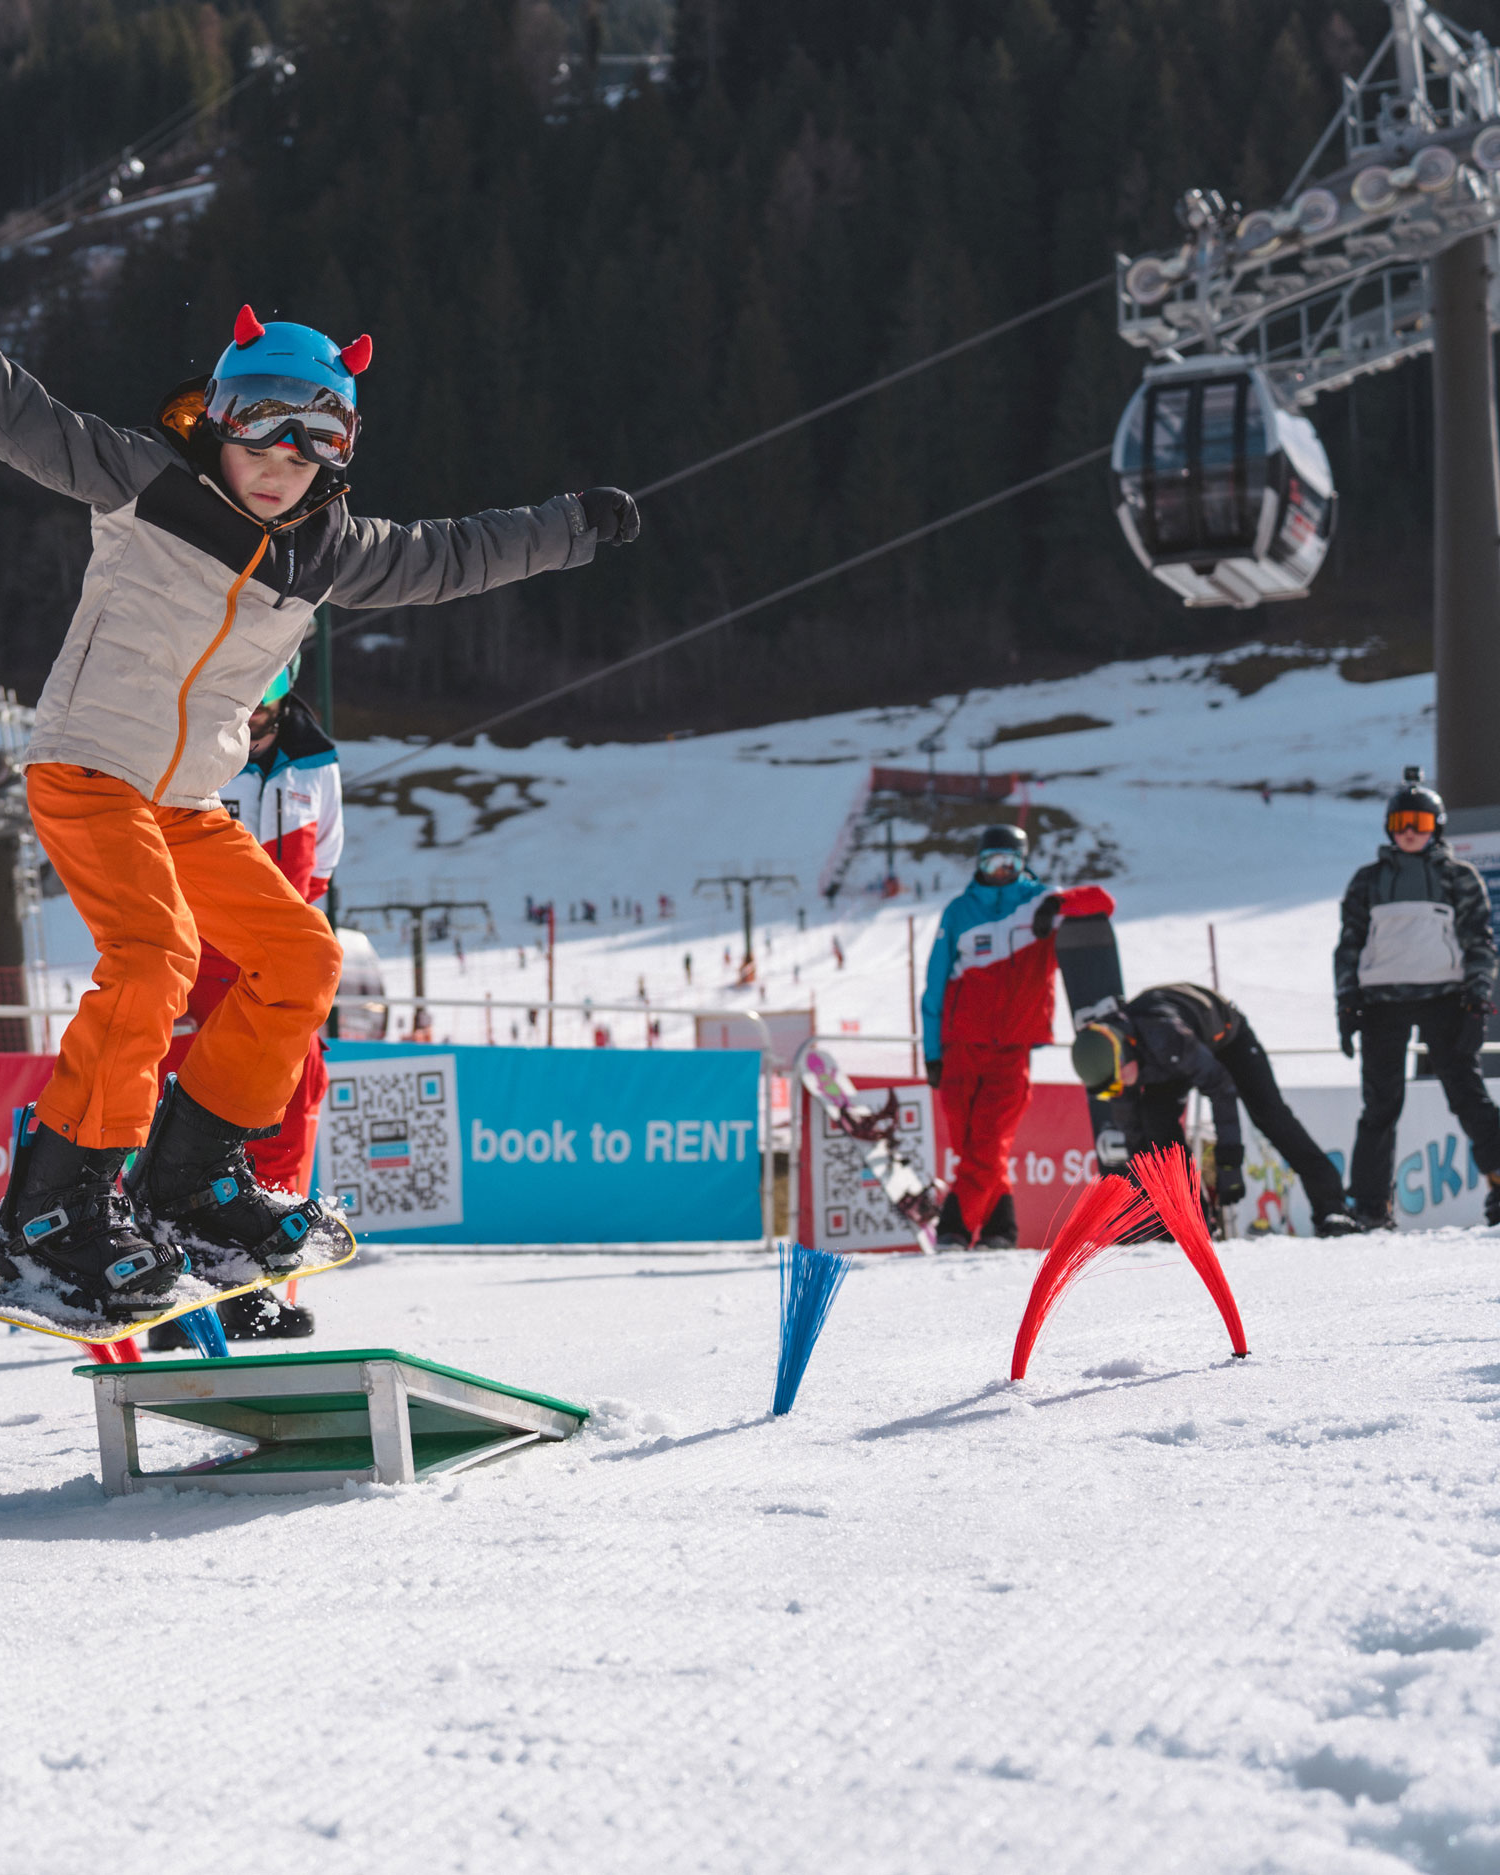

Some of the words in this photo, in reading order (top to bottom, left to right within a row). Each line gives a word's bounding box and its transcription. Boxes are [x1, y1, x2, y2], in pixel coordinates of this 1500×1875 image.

[472, 1119, 577, 1162] book
[590, 1123, 631, 1163] to
[646, 1121, 753, 1162] RENT
[1024, 1151, 1056, 1186] to
